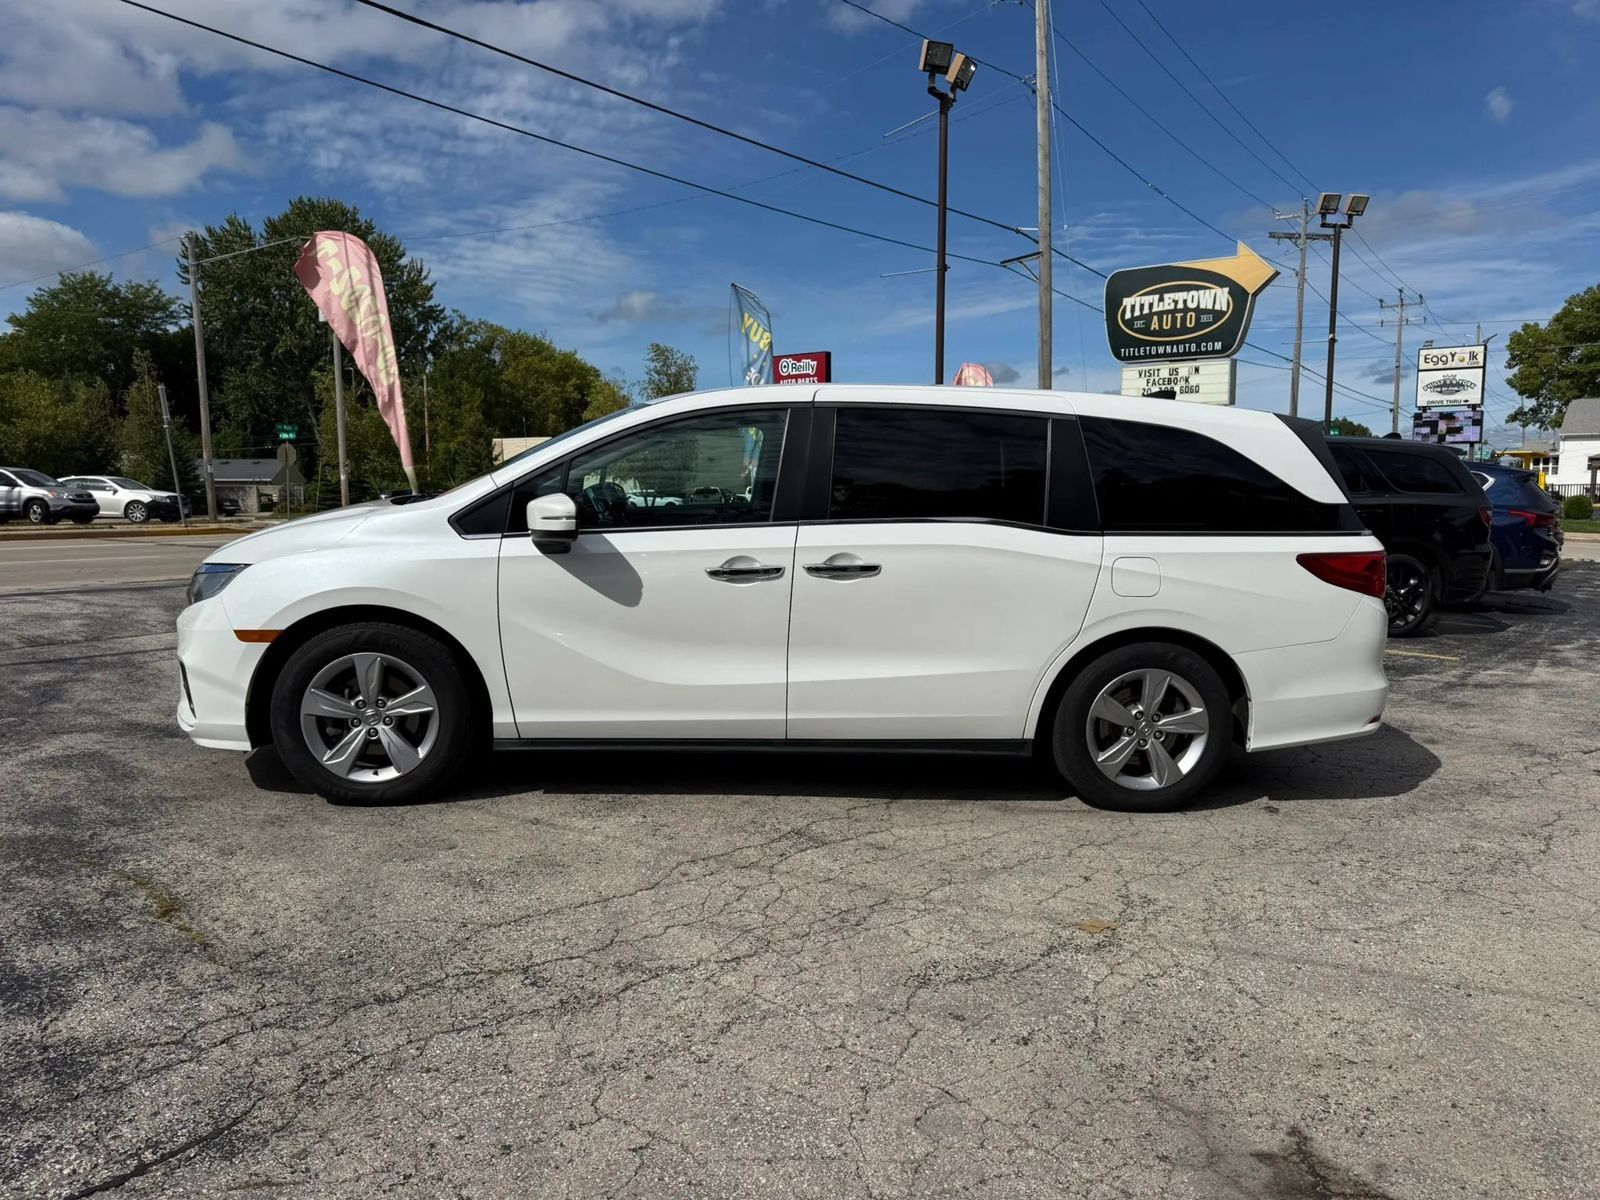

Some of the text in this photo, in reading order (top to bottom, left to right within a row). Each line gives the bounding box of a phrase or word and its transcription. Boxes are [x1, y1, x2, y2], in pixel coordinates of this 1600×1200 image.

[1123, 287, 1229, 320] TITLETOWN
[1150, 311, 1196, 331] AUTO
[1120, 341, 1222, 357] TITLETOWNAUTO.COM
[779, 358, 817, 376] O'Reilly
[1138, 368, 1161, 378] VISIT
[1168, 367, 1179, 376] US
[1146, 375, 1190, 387] FACEBOOK
